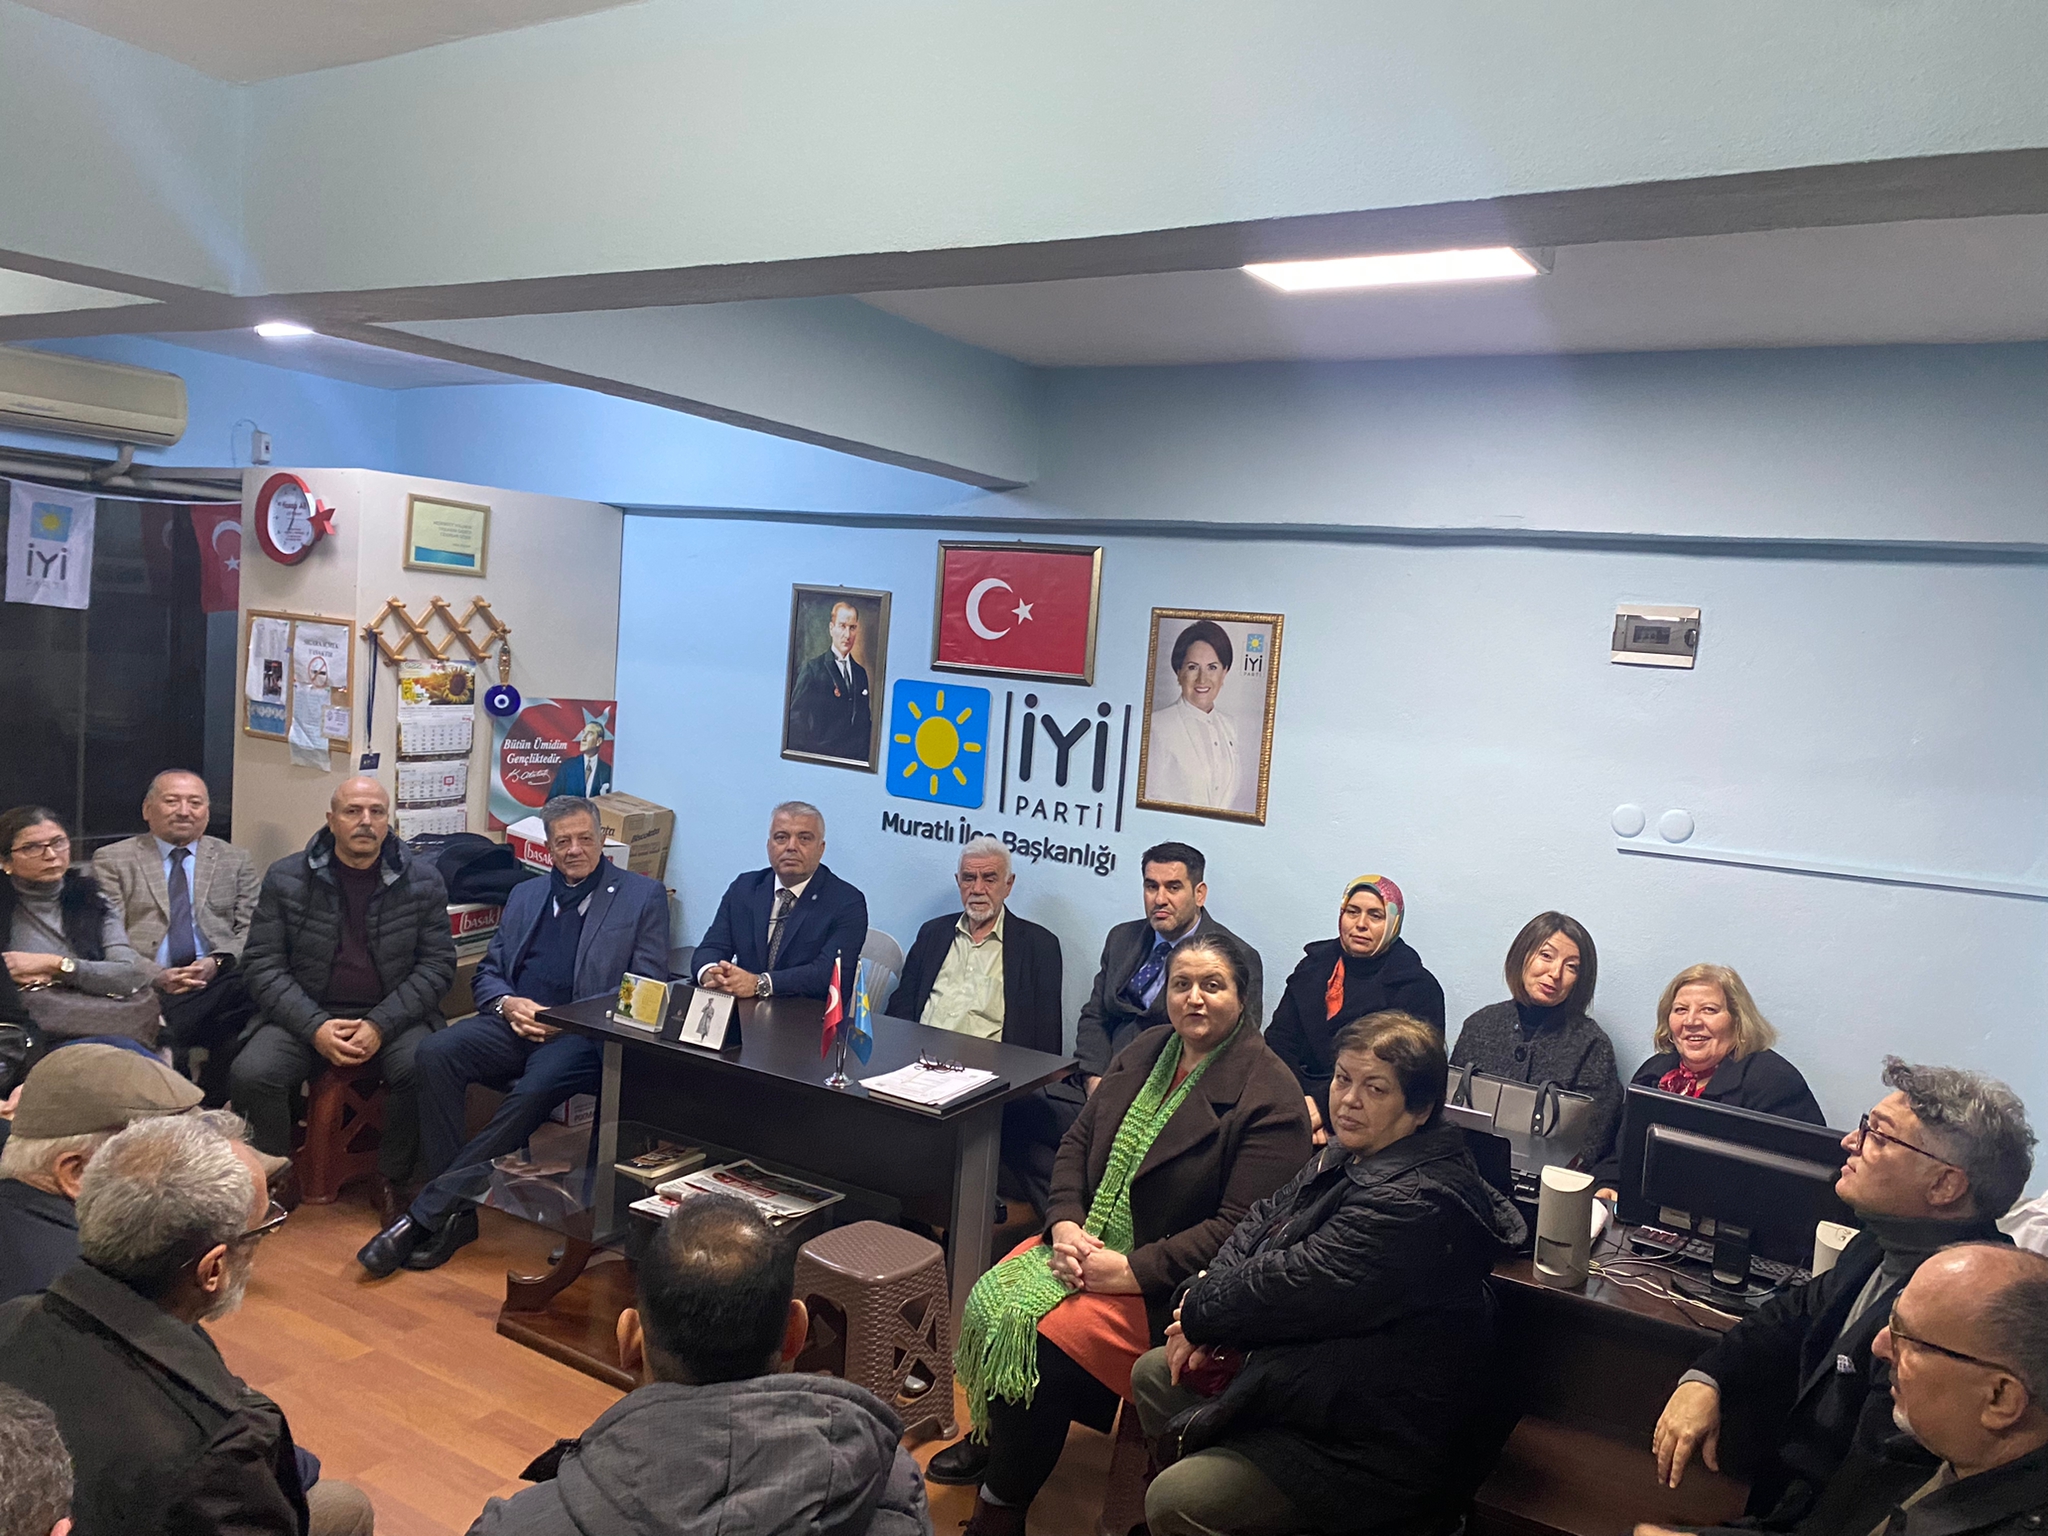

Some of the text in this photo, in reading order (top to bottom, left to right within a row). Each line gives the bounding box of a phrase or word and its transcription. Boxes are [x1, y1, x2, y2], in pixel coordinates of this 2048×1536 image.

[26, 542, 69, 581] İYİ
[1244, 654, 1263, 672] İYİ
[503, 736, 568, 750] Bütün Ümidim
[506, 752, 562, 766] Gençliktedir.
[1019, 693, 1112, 793] İYİ
[1015, 796, 1104, 829] PARTİ
[881, 811, 954, 843] Muratlı
[1002, 831, 1117, 877] Başkanlığı
